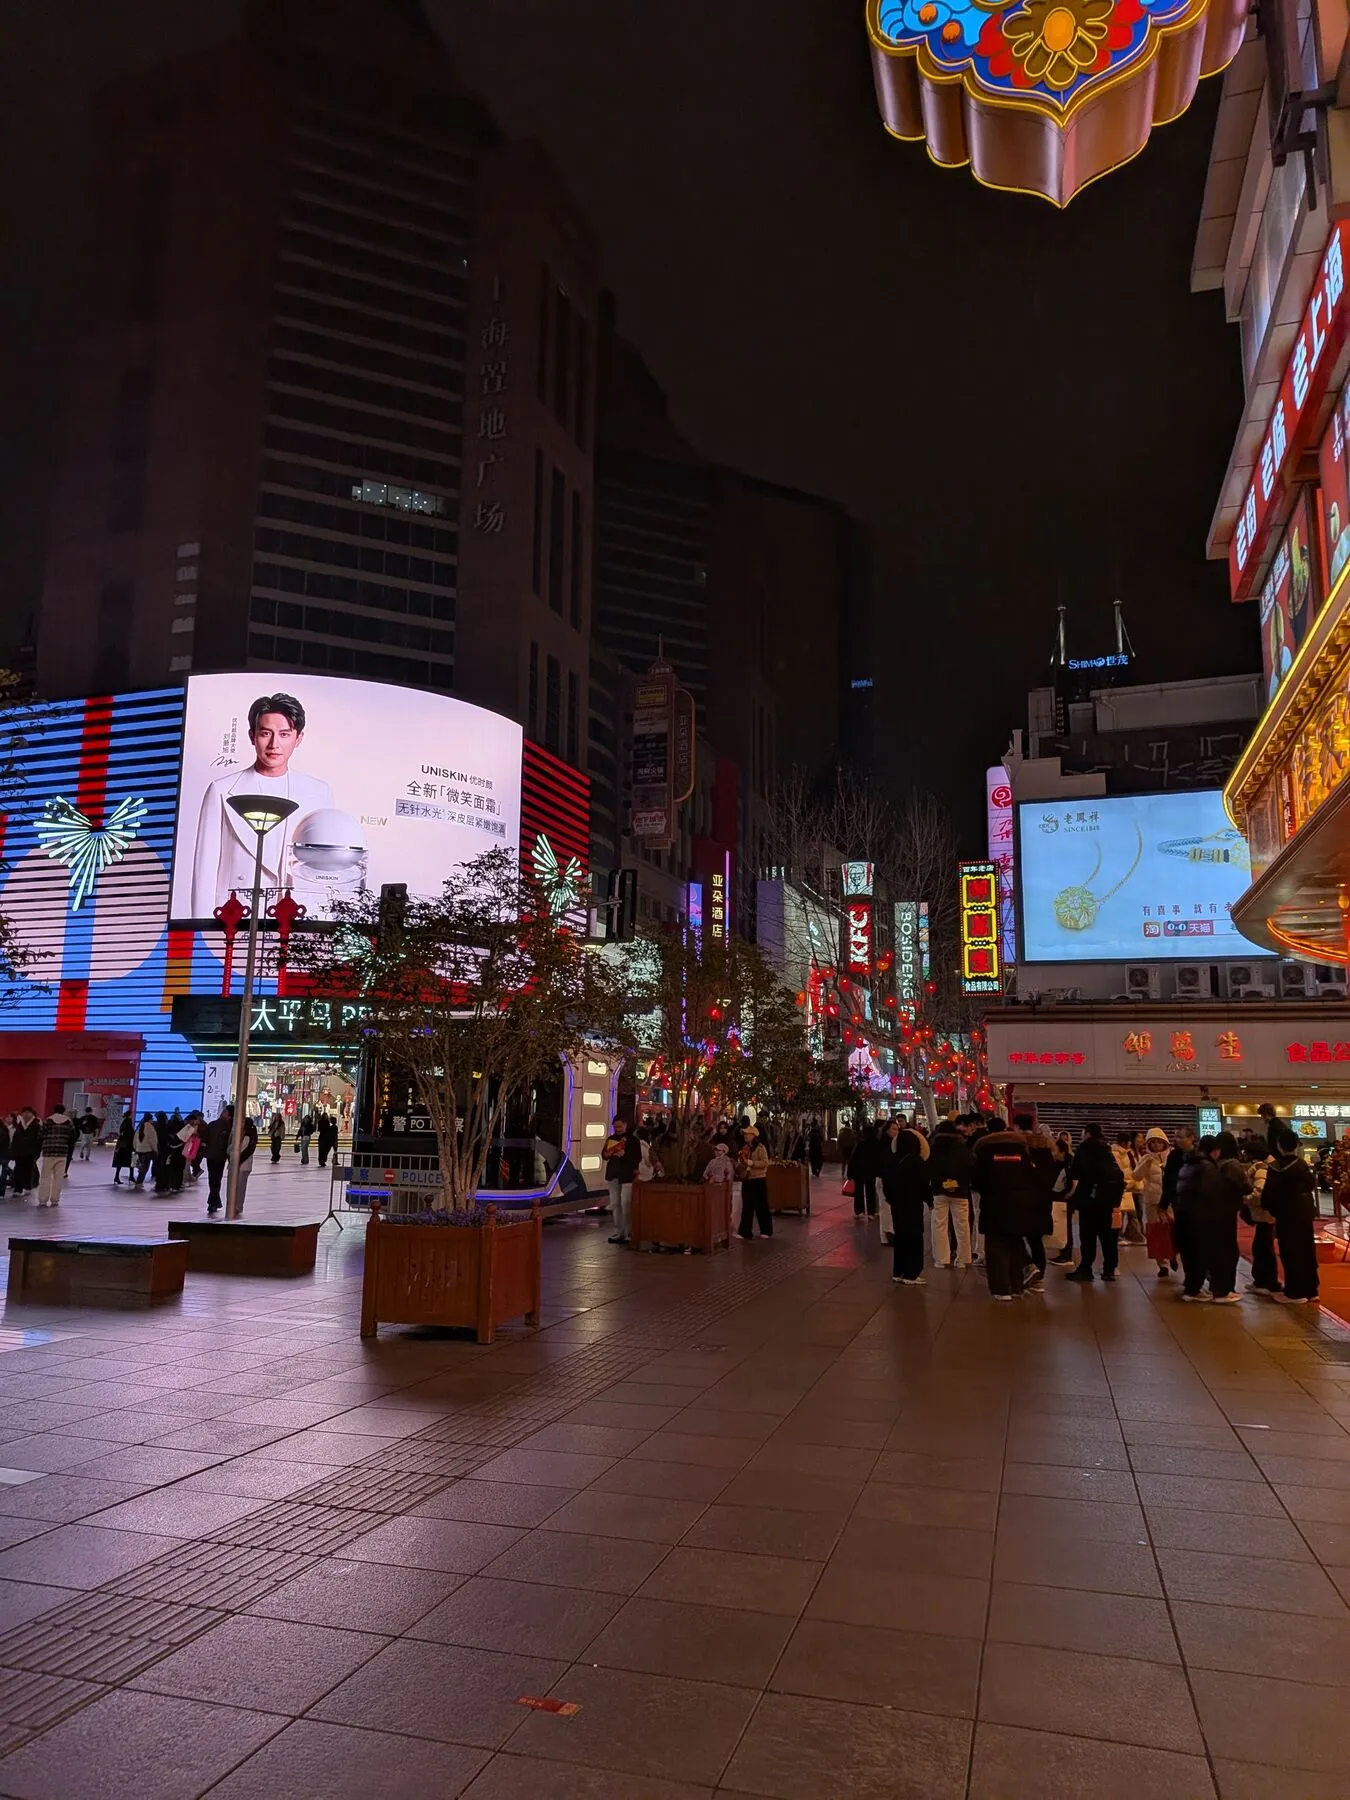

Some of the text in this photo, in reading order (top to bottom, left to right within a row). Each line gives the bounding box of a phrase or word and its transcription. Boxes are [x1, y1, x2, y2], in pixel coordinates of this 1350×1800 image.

[421, 764, 493, 790] UNISKIN 优时颜
[361, 815, 388, 826] NEW
[315, 872, 339, 880] UNISKIN
[712, 874, 723, 938] 亚朵酒店
[1190, 923, 1211, 933] 天猫
[849, 910, 869, 965] KFC
[900, 911, 914, 999] BOSIDENG
[965, 981, 999, 992] 食品有限公司
[402, 1171, 442, 1184] POLICE
